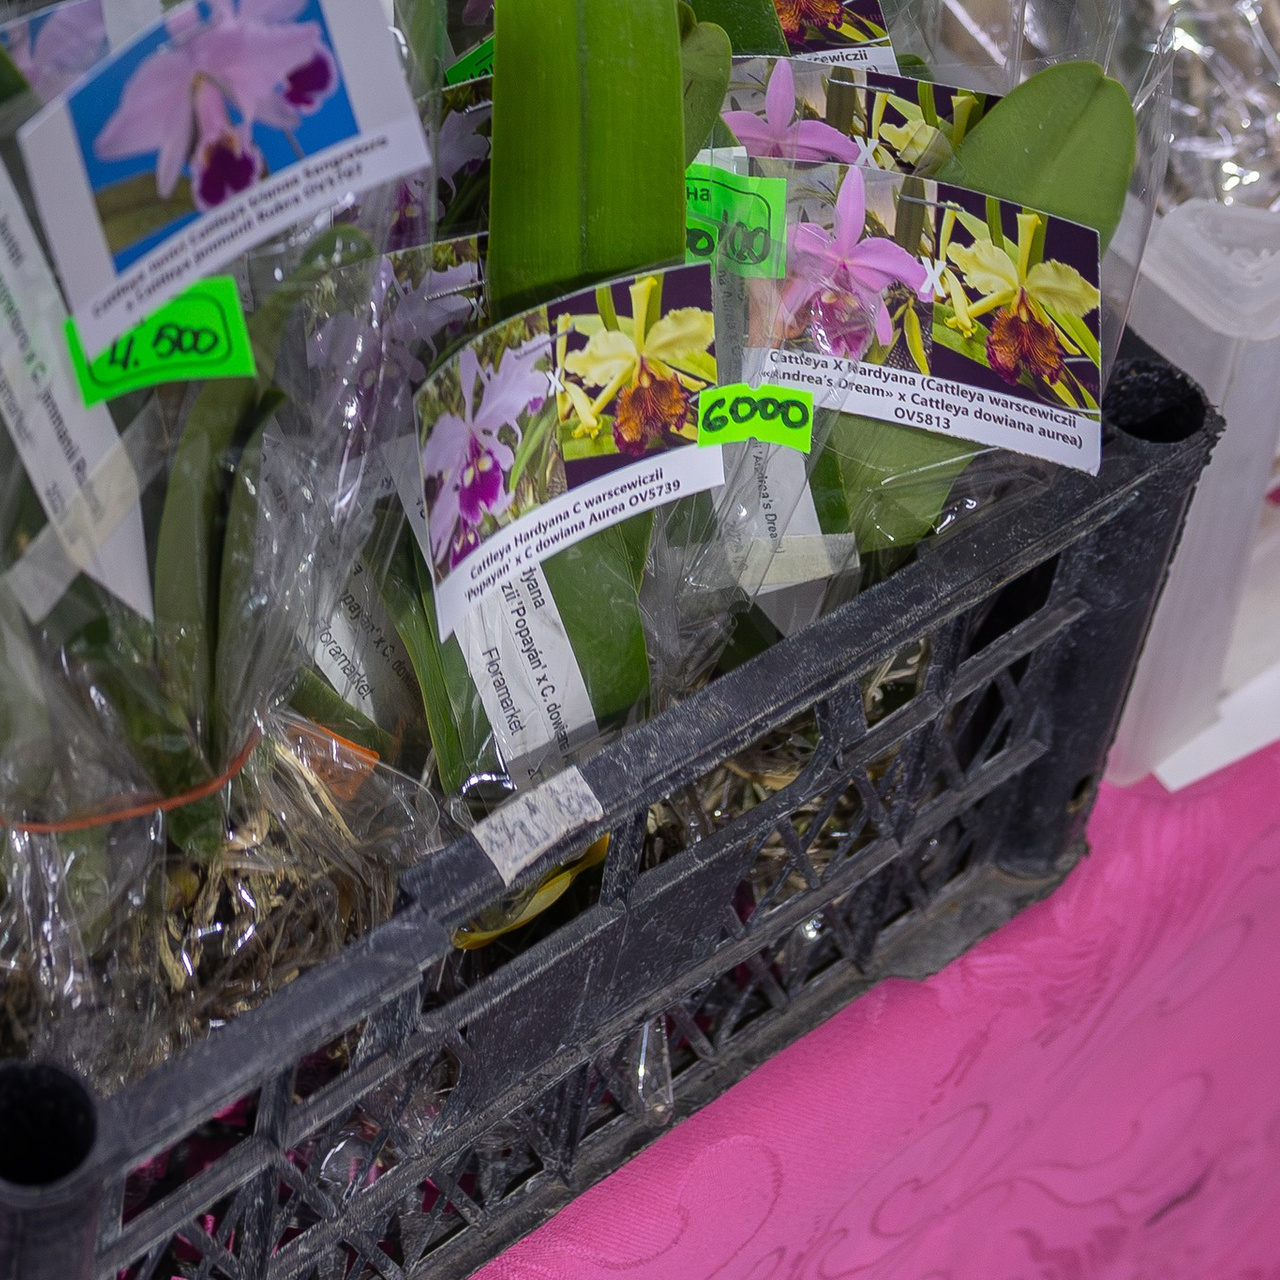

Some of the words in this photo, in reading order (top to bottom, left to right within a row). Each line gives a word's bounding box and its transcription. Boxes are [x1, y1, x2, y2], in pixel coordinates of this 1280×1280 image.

[700, 395, 810, 434] 6000
[769, 350, 831, 373] Cattleya
[919, 376, 986, 405] (Cattleya
[988, 395, 1078, 429] warscewiczii
[892, 406, 952, 431] OV5813
[897, 391, 908, 404] x
[909, 392, 971, 419] Cattleya
[972, 406, 1035, 435] dowiana
[1037, 426, 1085, 451] aurea)
[470, 541, 513, 581] Cattleya
[513, 508, 573, 548] Hardyana
[572, 500, 583, 515] C
[582, 467, 665, 509] warscewiczii
[524, 544, 535, 561] C
[535, 520, 587, 555] dowiana
[588, 502, 627, 527] Aurea
[628, 478, 682, 508] OV5739
[481, 645, 524, 737] Floramarket
[535, 673, 549, 687] x
[540, 683, 557, 704] C.
